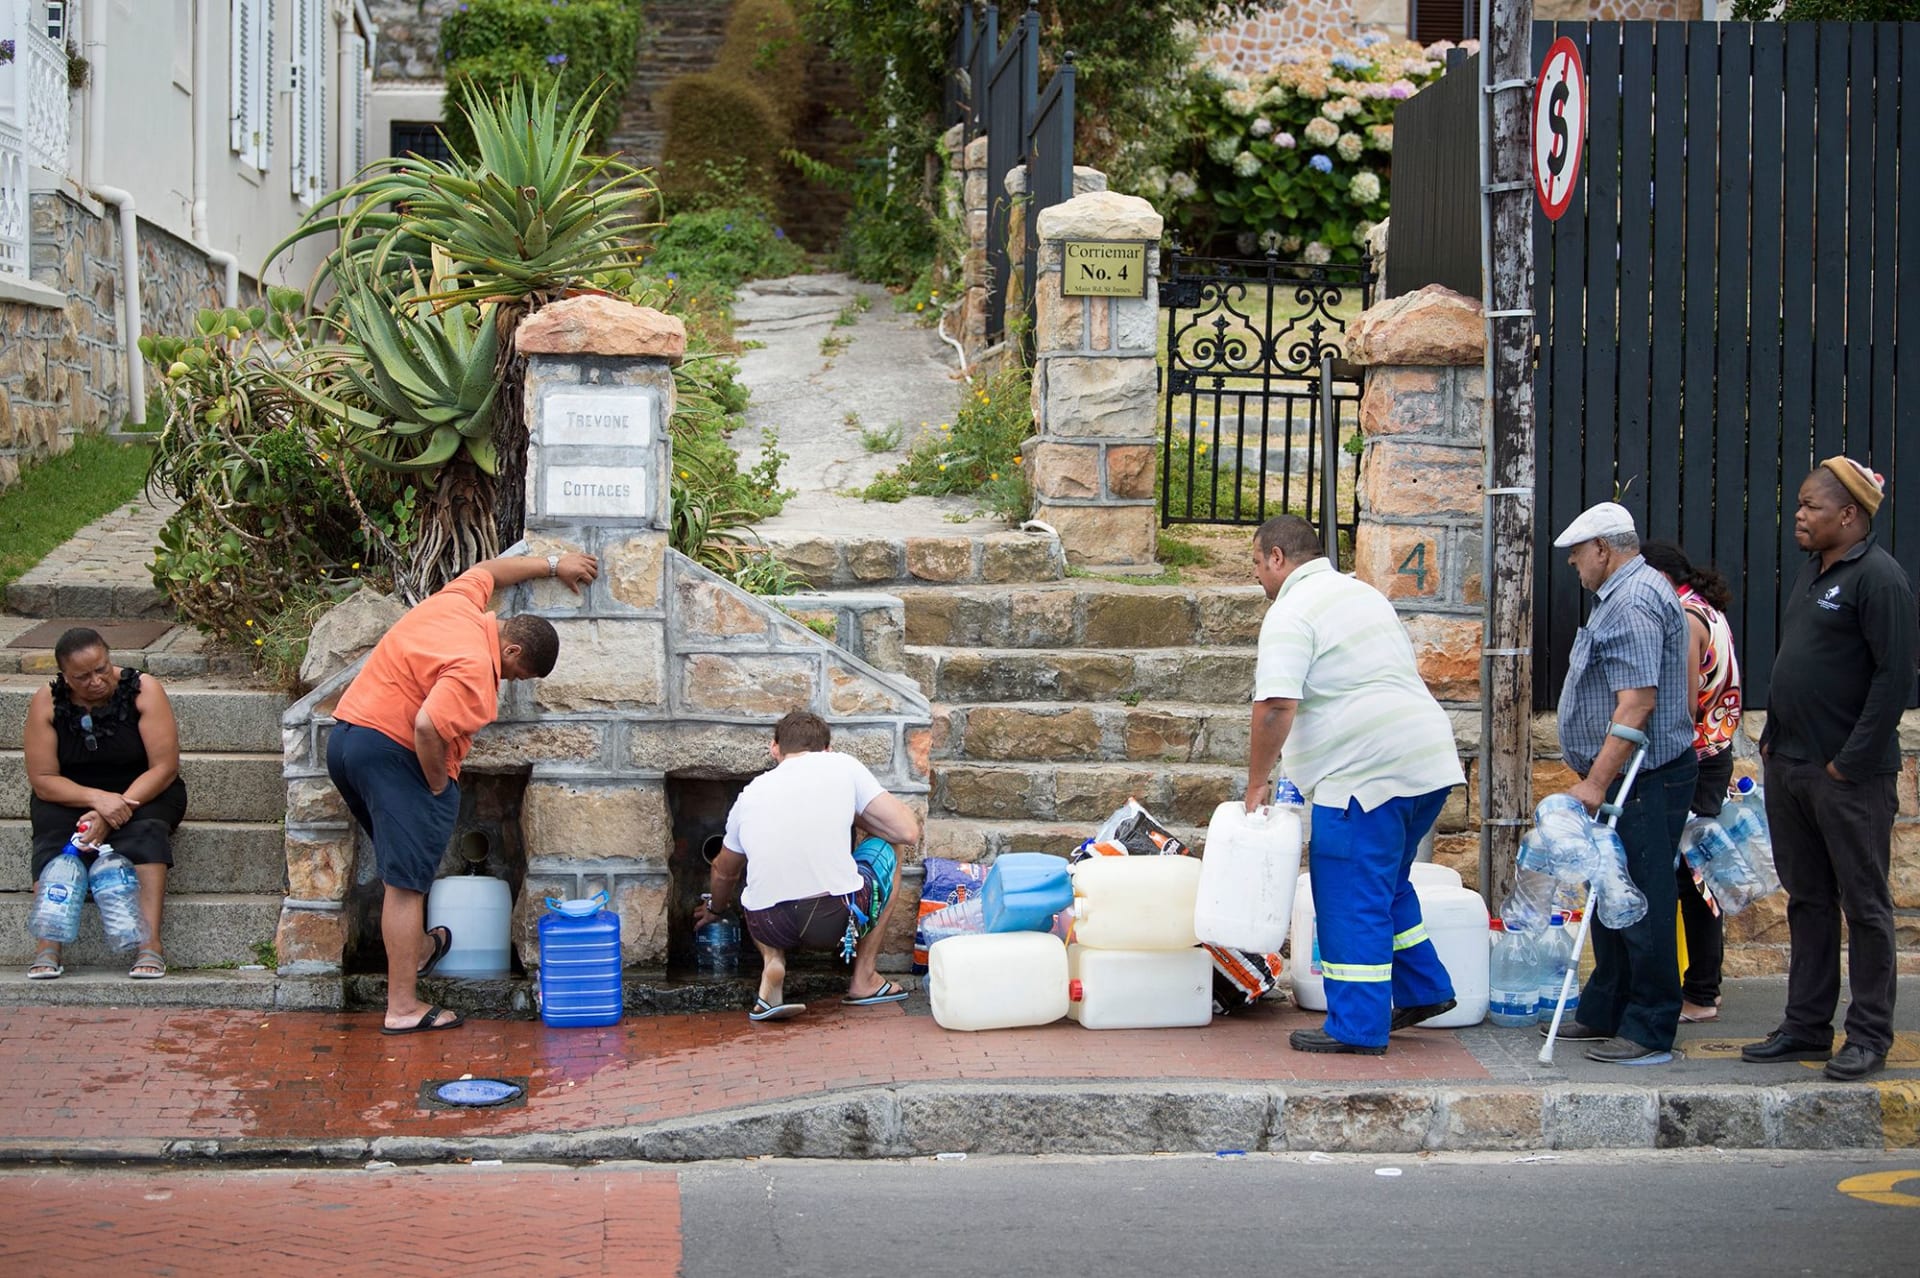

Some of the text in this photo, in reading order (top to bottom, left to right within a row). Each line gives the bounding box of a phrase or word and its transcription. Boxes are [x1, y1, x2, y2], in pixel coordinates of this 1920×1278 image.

[1068, 244, 1140, 259] Corriemar
[1080, 264, 1129, 280] No. 4
[566, 412, 630, 428] TREVONE
[563, 480, 631, 498] COTTAGES
[1397, 542, 1428, 591] 4
